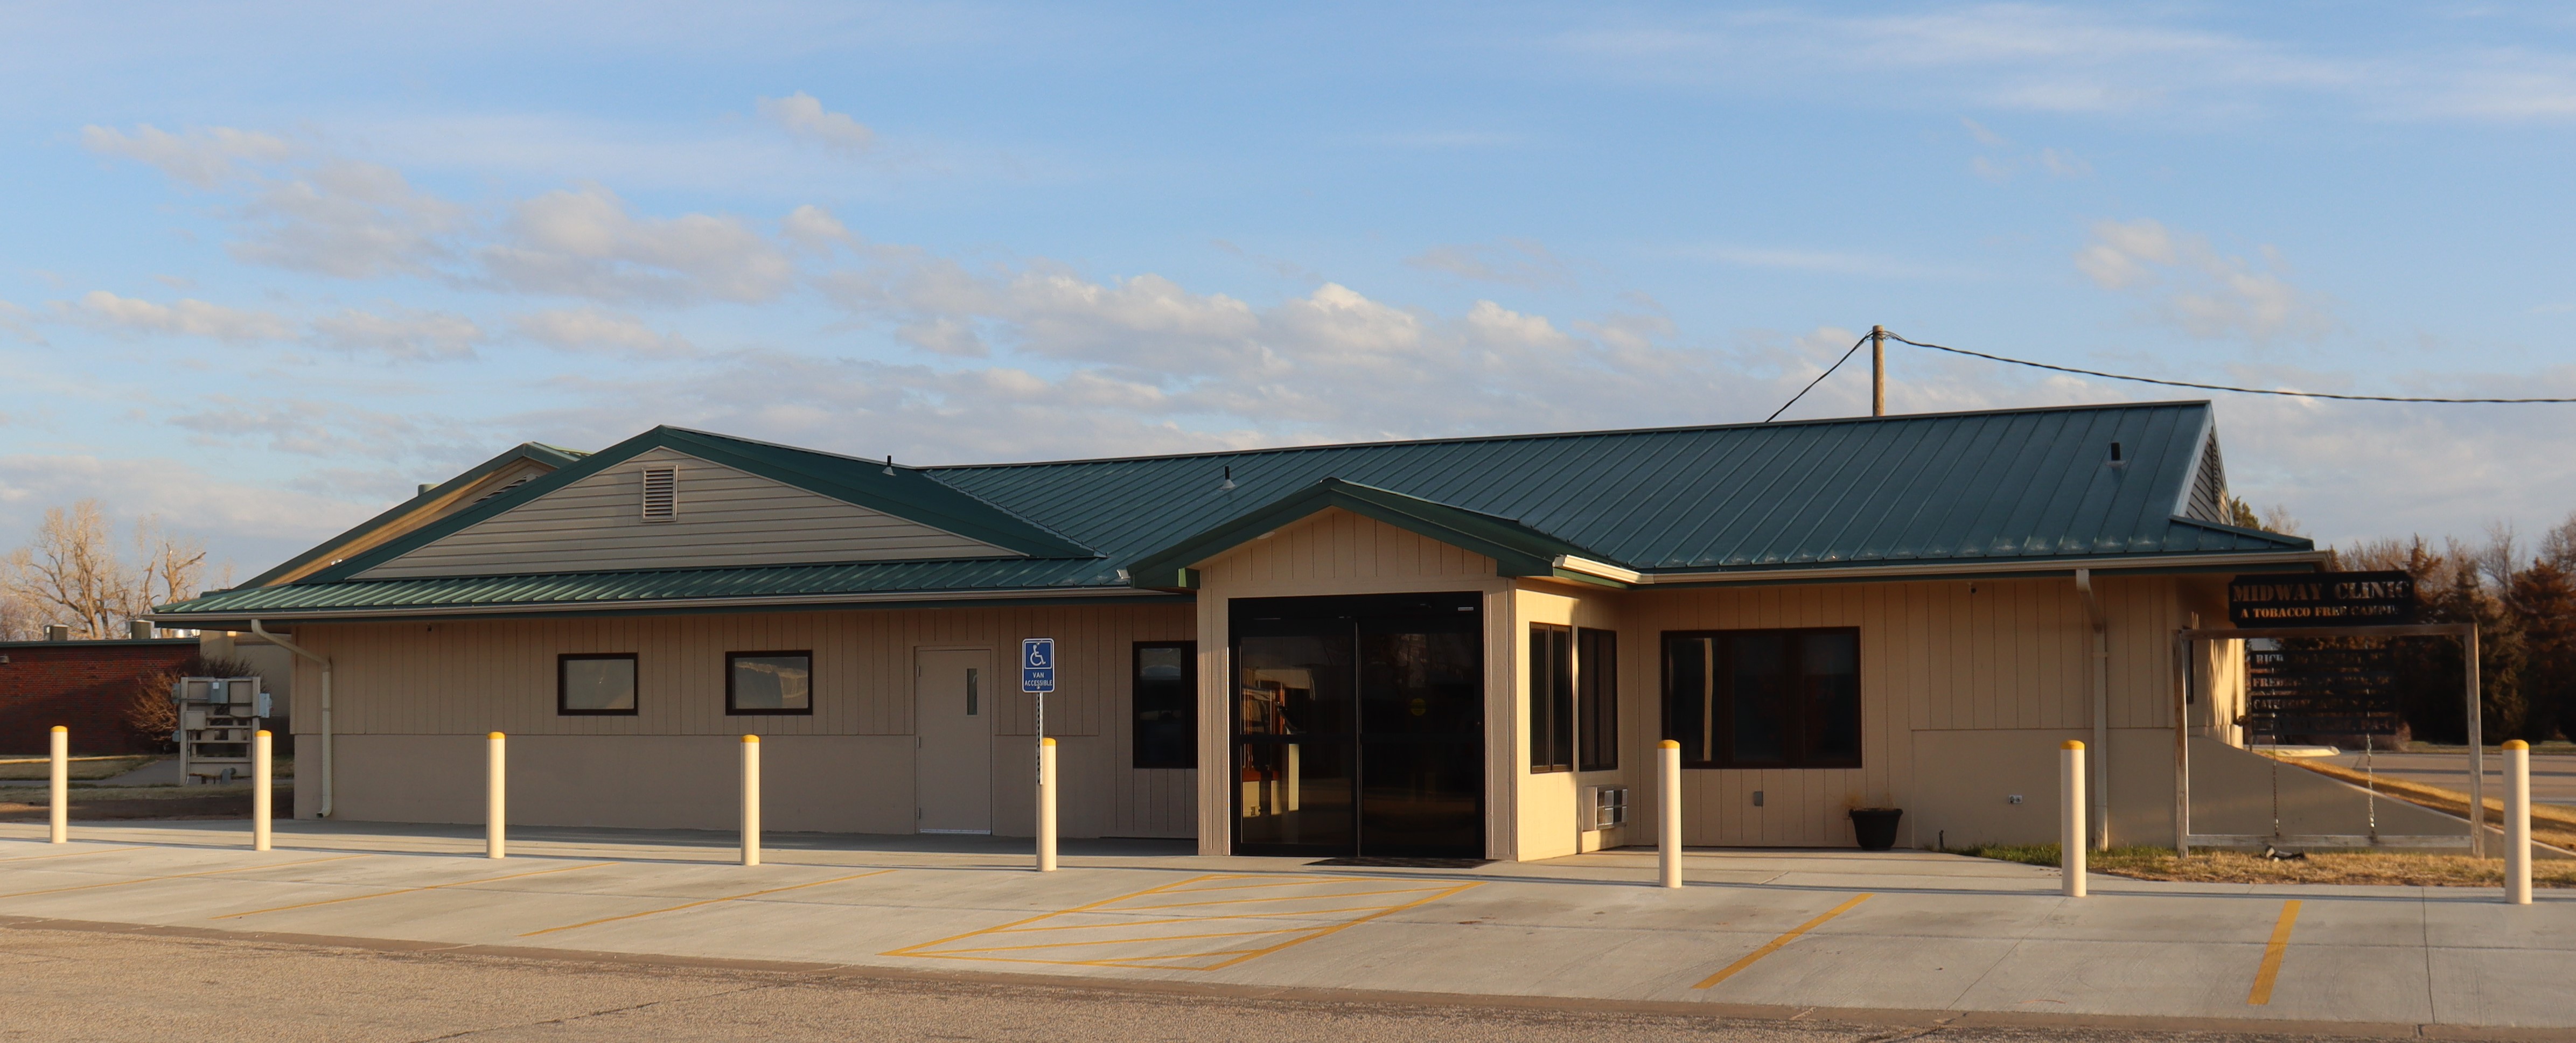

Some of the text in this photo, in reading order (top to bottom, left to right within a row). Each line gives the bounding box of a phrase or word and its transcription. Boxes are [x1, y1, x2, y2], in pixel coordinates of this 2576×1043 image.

[2233, 581, 2410, 602] MIDWAY CLINIC
[2241, 605, 2403, 618] A TOBACCO FREE CAMPU
